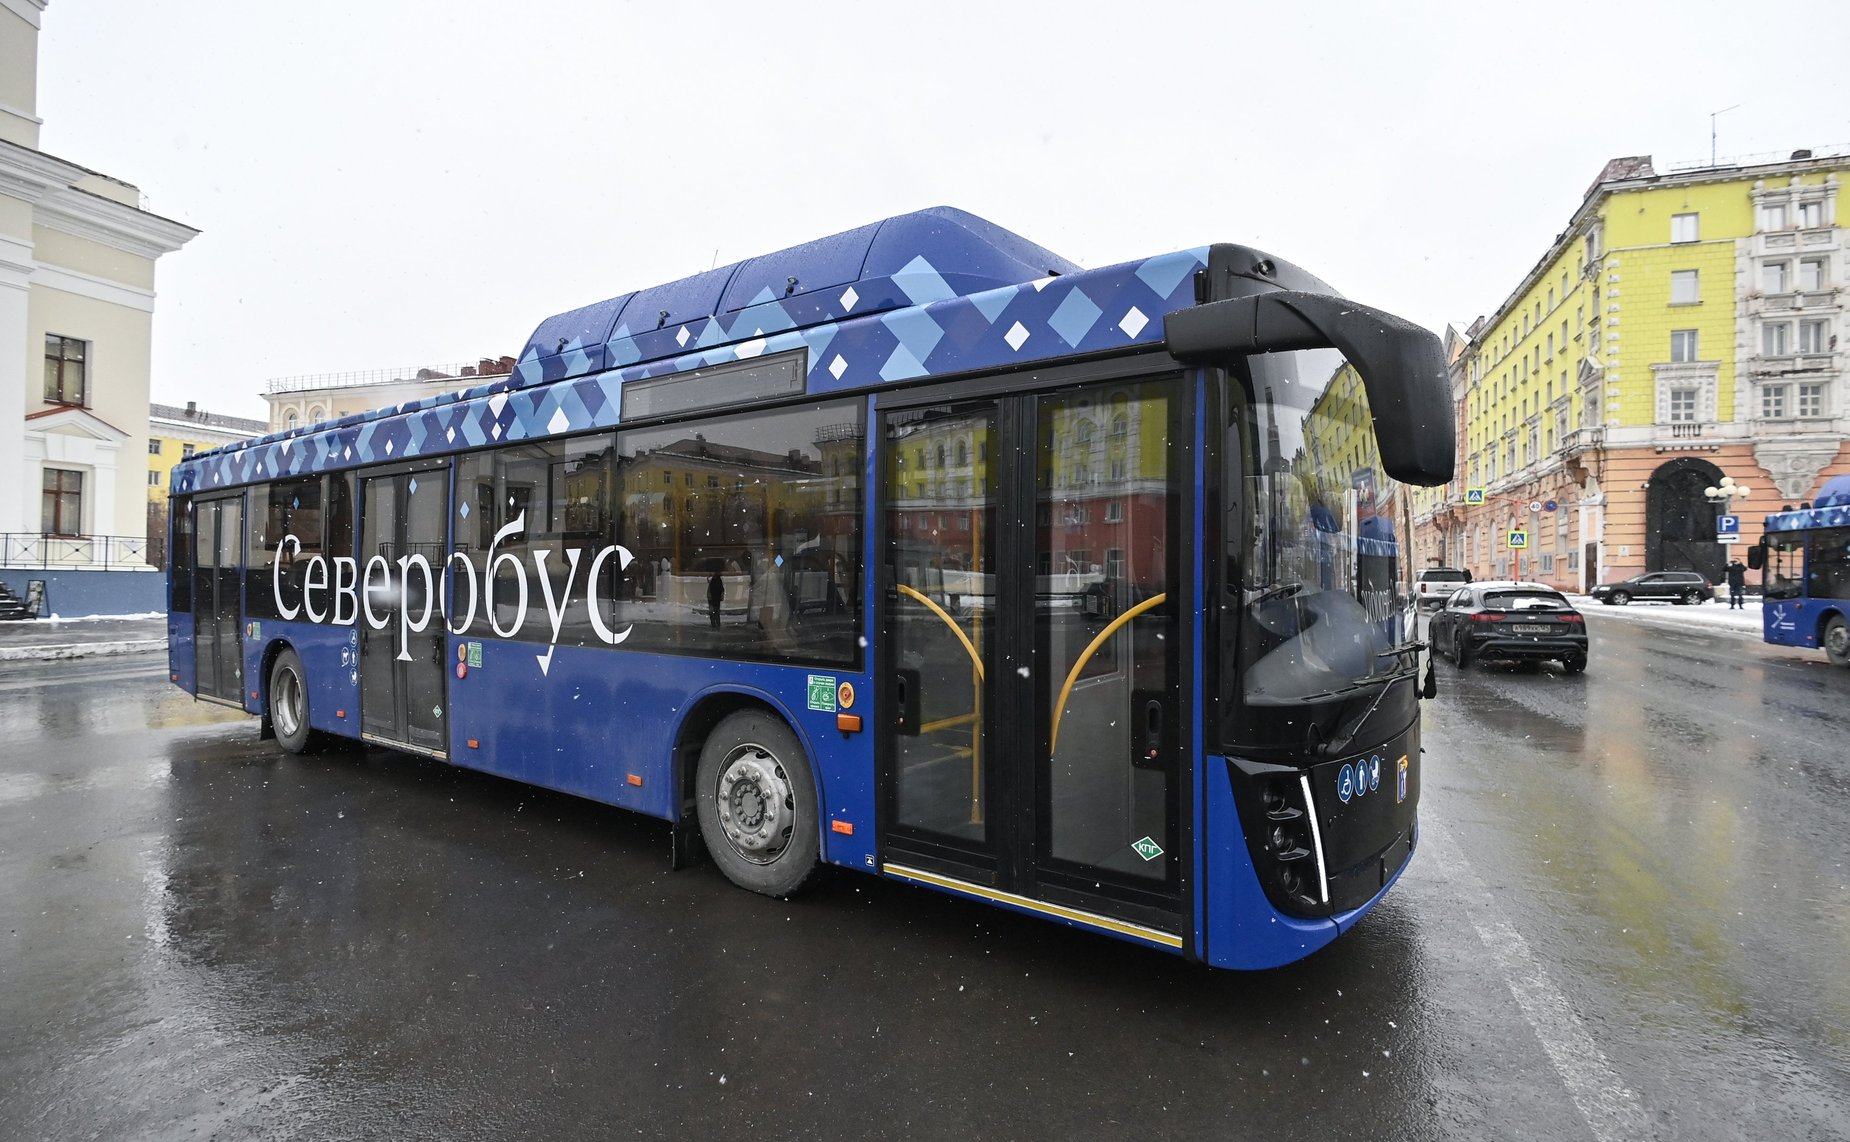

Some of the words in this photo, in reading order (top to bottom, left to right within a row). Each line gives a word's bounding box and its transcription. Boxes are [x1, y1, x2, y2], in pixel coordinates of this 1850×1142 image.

[1721, 517, 1735, 531] P
[274, 508, 635, 676] Северобус
[1138, 843, 1157, 854] КПГ
